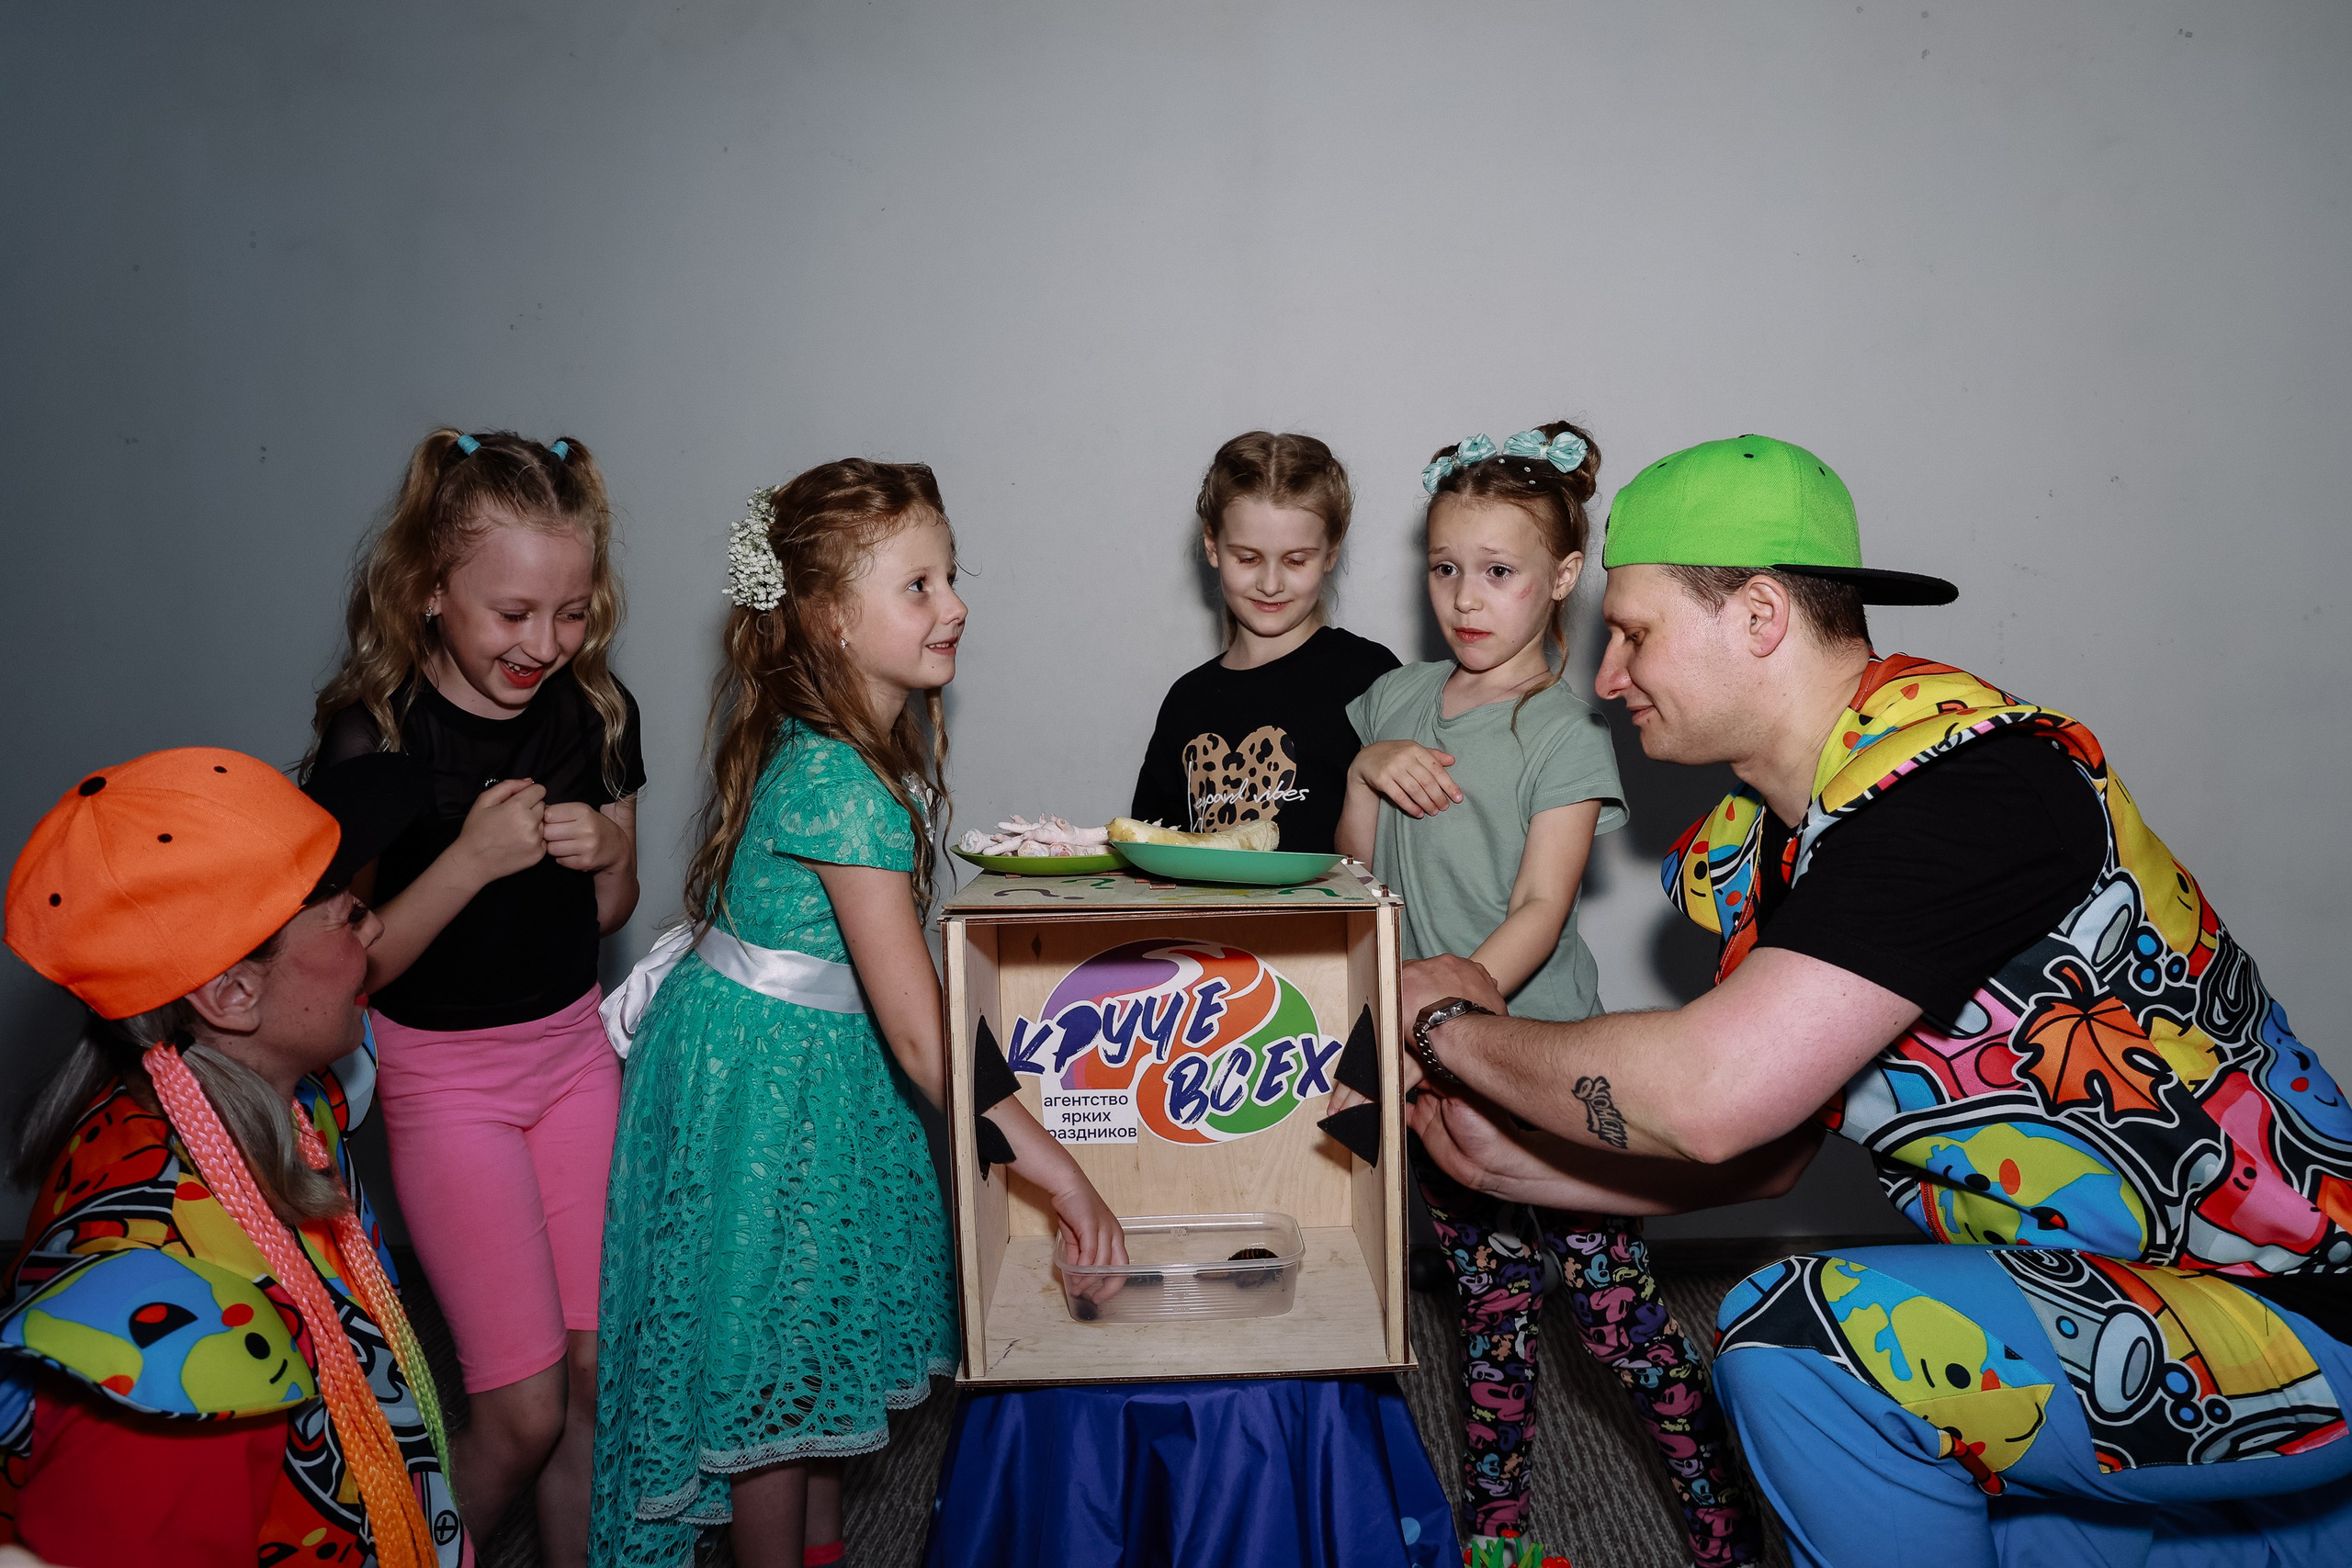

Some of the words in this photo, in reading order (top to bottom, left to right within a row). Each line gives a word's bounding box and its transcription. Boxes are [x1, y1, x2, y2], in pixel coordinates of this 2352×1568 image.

[1253, 780, 1310, 804] vibes
[1008, 981, 1227, 1075] КРУЧЕ
[1168, 1037, 1343, 1125] ВСЕХ
[1044, 1094, 1128, 1108] агентство
[1062, 1111, 1111, 1123] ярких
[1046, 1127, 1137, 1141] раздников
